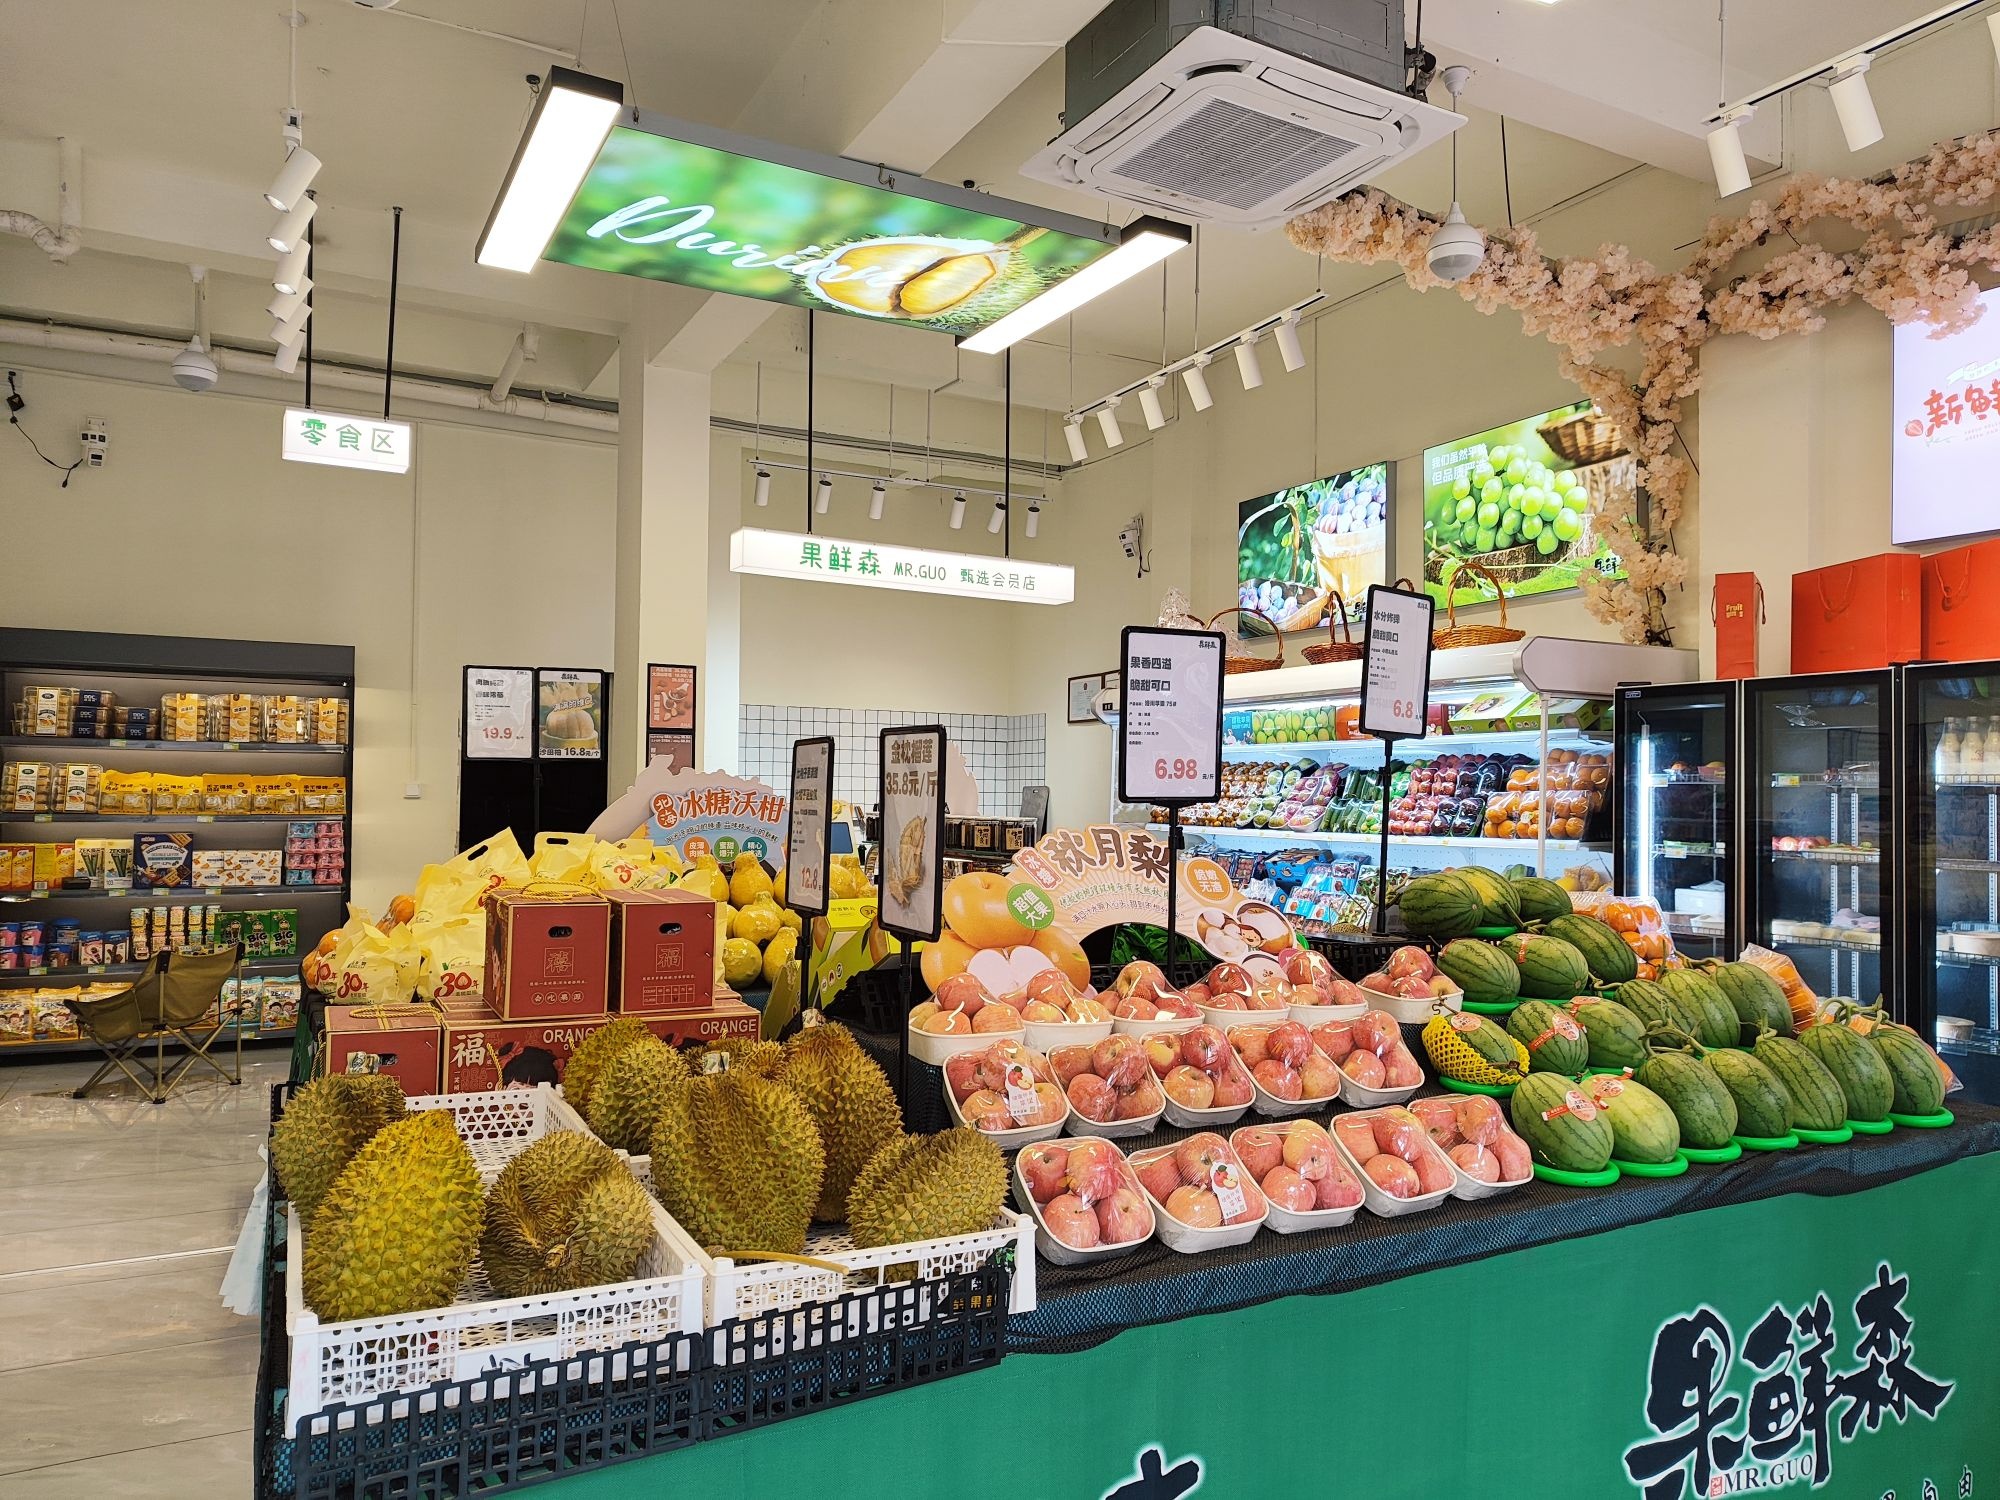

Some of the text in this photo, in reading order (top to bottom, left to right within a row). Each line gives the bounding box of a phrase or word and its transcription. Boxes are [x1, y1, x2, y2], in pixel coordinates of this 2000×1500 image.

[587, 195, 908, 288] Durian
[300, 418, 395, 454] 零食区
[799, 542, 1036, 591] 果鲜森 MR.GUO 甄选会员店
[1130, 656, 1172, 670] 果香四溢
[1129, 679, 1171, 691] 脆甜可口
[1393, 699, 1414, 718] 6.8
[482, 727, 512, 739] 19.9
[890, 739, 934, 764] 金枕榴莲
[1154, 758, 1198, 780] 6.98
[886, 770, 938, 798] 35.8元/斤
[656, 788, 786, 826] 北海 冰糖沃柑
[689, 841, 705, 850] 皮薄
[747, 842, 763, 850] 精心
[1042, 828, 1169, 884] 秋月梨
[801, 867, 819, 892] 12.8
[247, 932, 267, 942] BIG
[273, 931, 294, 942] BIG
[657, 947, 681, 968] 福
[542, 1028, 595, 1044] ORANG
[701, 1018, 757, 1035] ORANGE
[450, 1032, 486, 1068] 福
[1624, 1261, 1955, 1500] 果鲜森
[1722, 1453, 1814, 1495] MR.GUO
